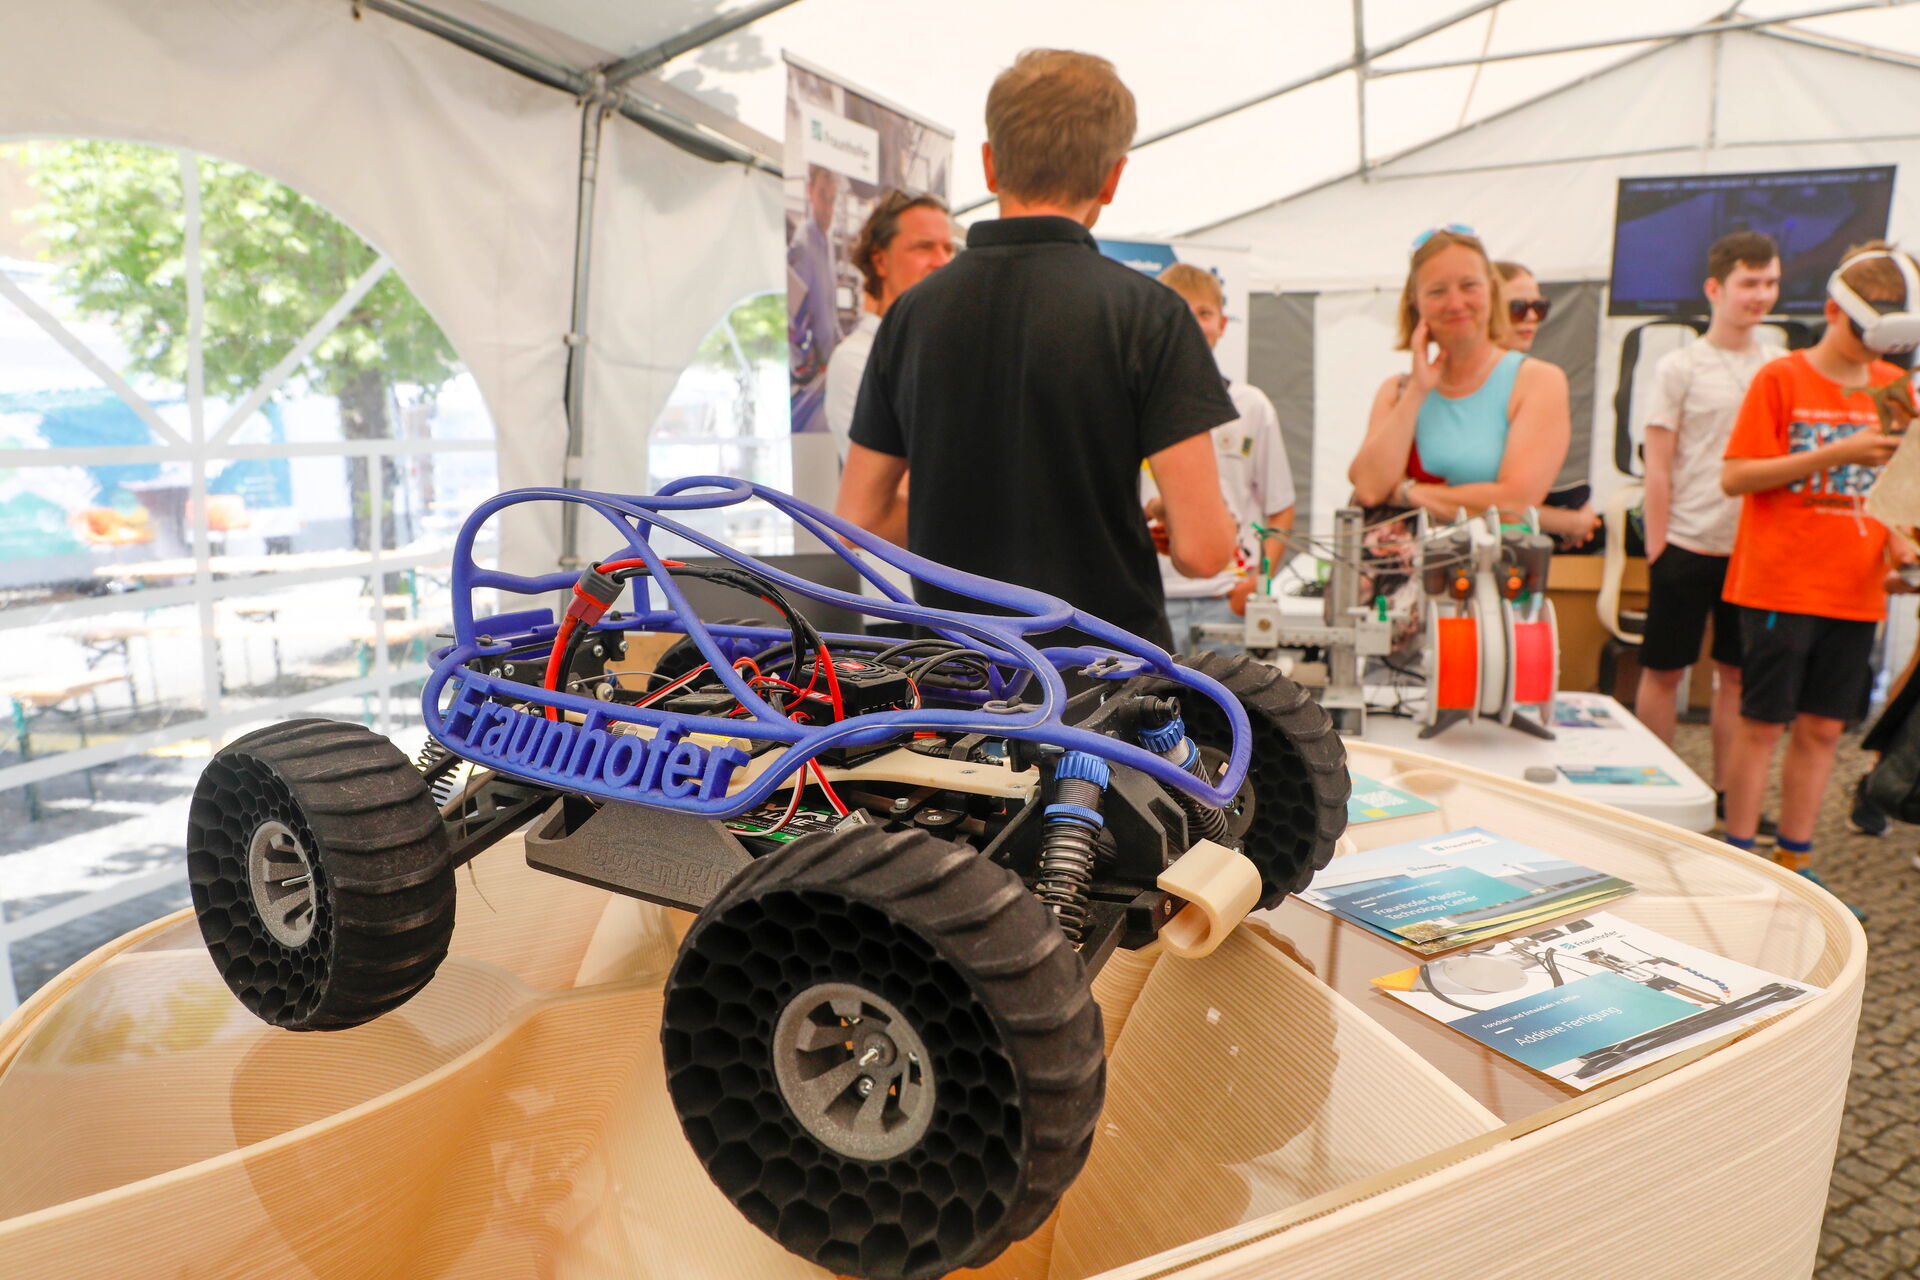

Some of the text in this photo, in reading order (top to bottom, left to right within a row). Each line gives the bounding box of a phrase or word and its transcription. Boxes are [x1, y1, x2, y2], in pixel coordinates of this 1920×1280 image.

[438, 677, 751, 800] Fraunhofer
[1373, 889, 1466, 915] Fraunhofer Plastics
[1385, 895, 1478, 920] Technology Center
[1574, 930, 1618, 946] Fraunhofer
[1481, 1017, 1511, 1030] Forschen
[1512, 1012, 1523, 1021] und
[1515, 1006, 1622, 1047] Additive Fertigung
